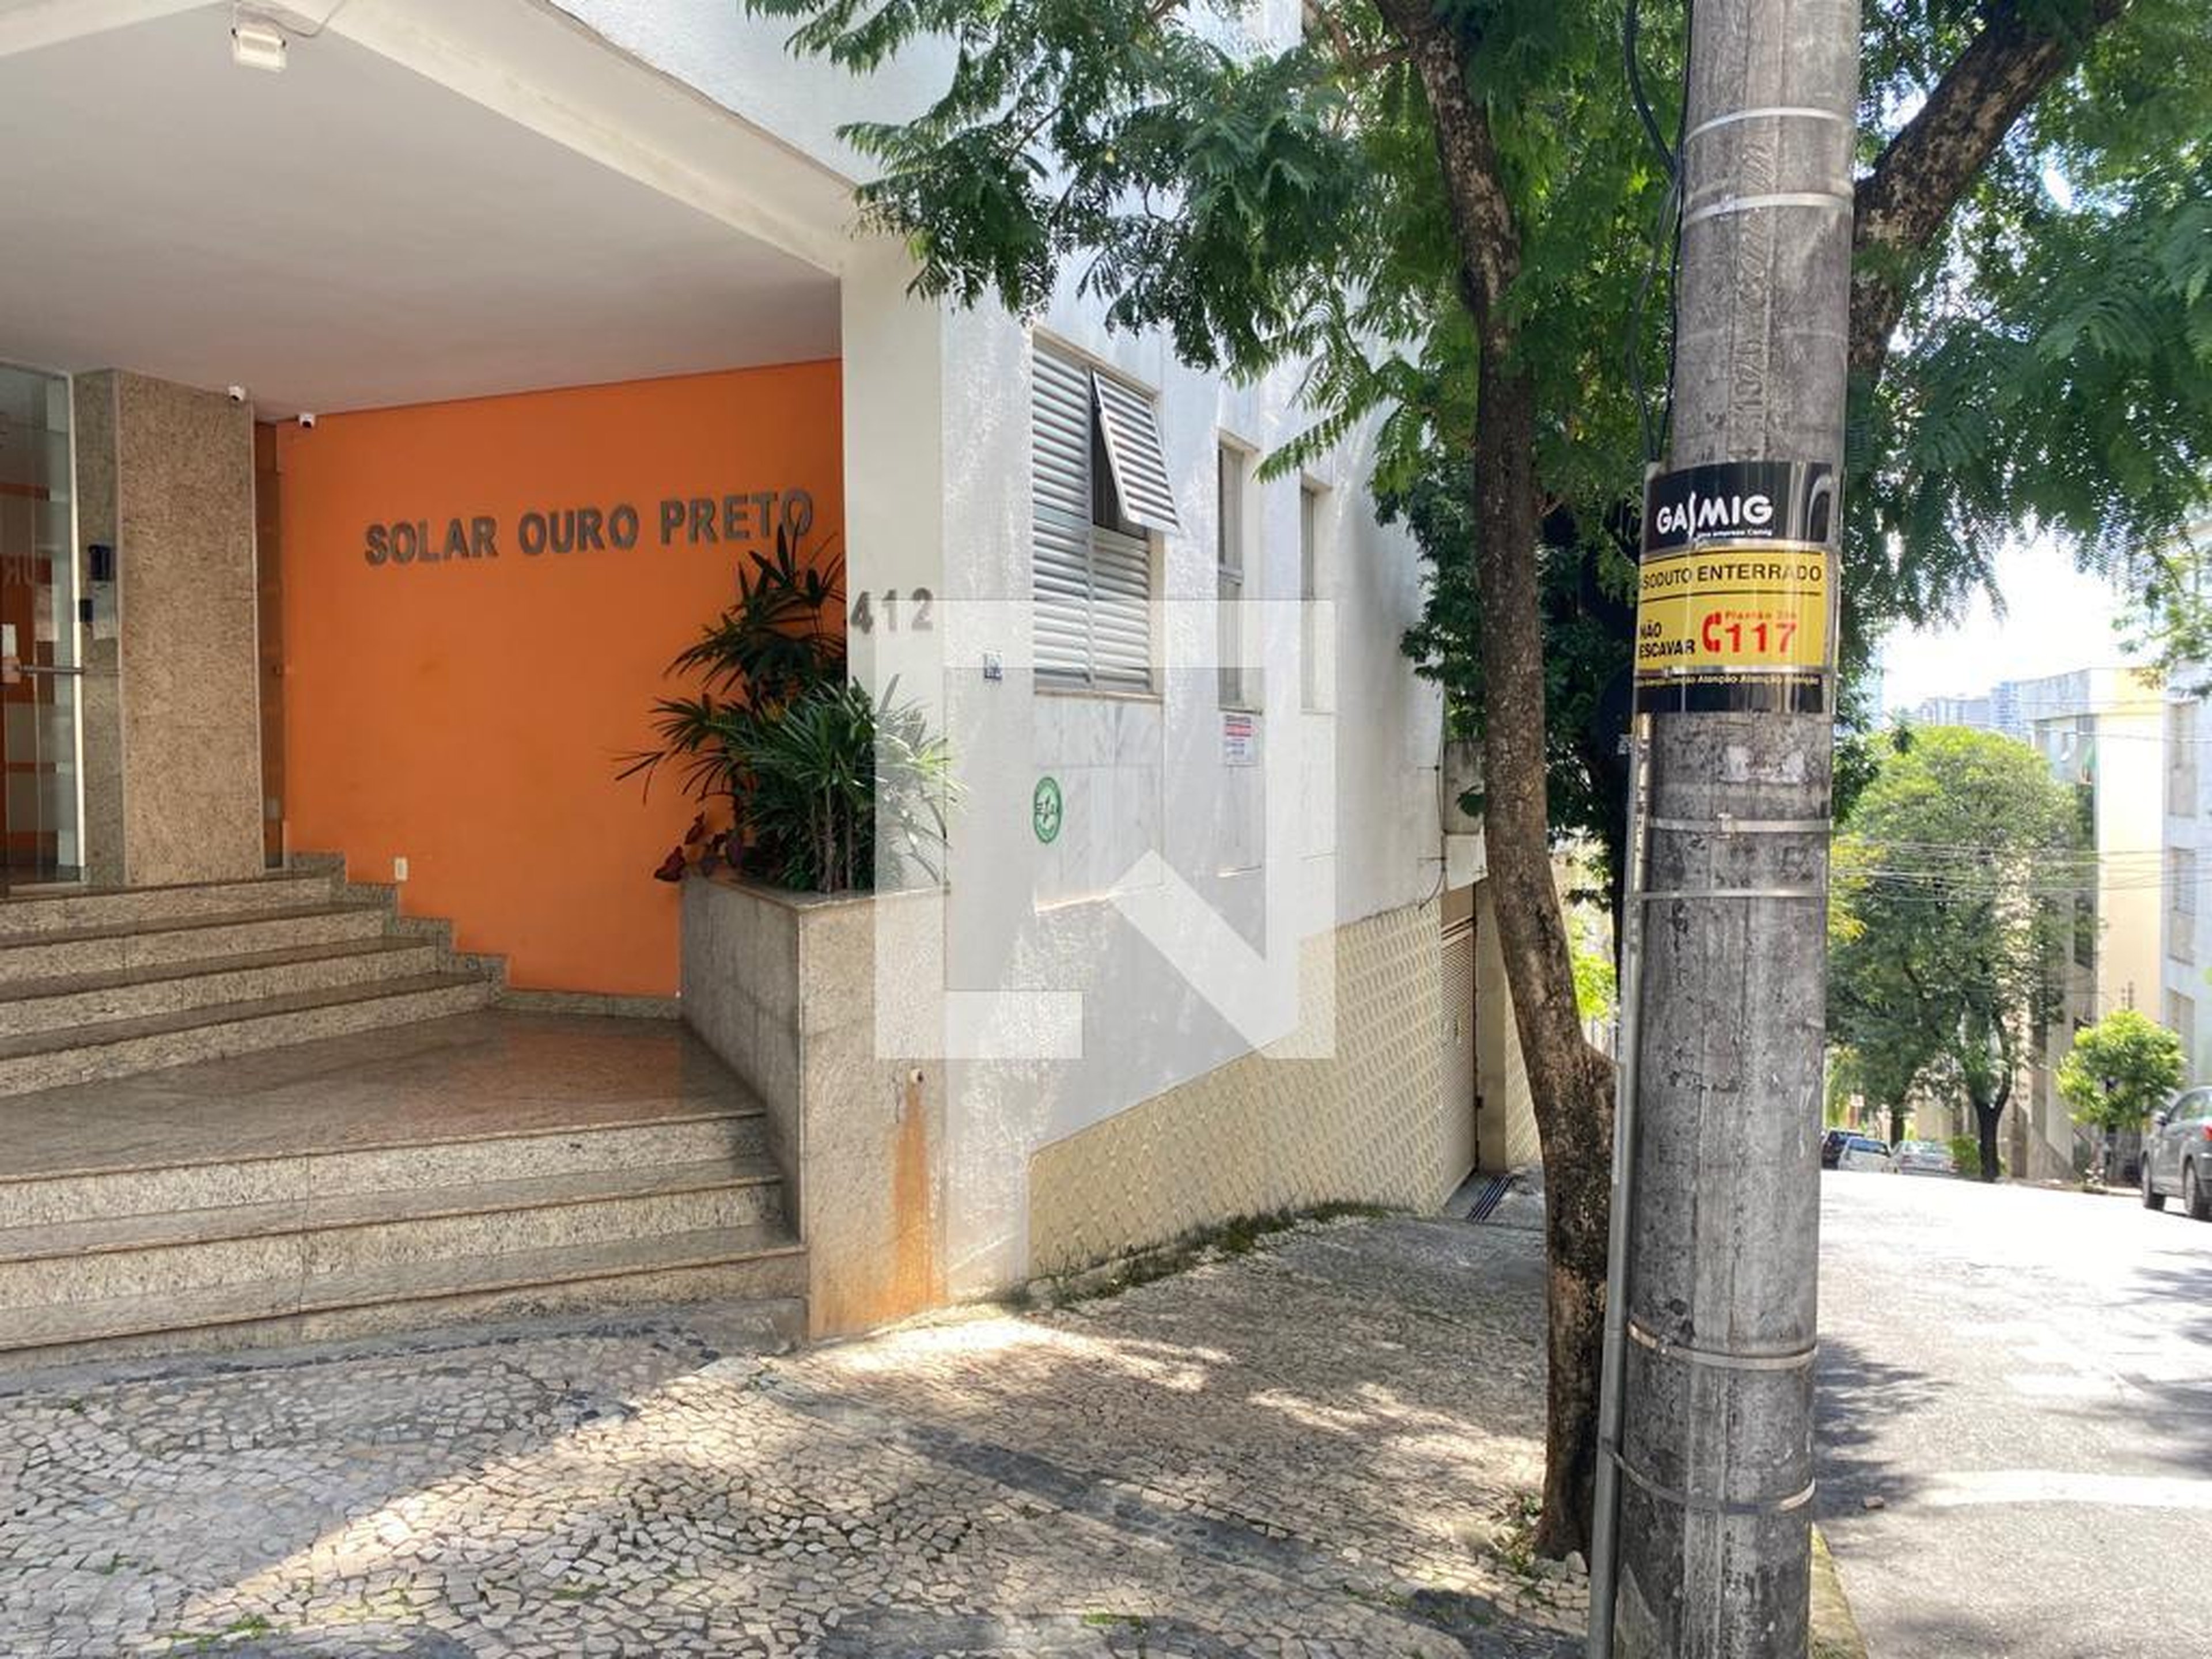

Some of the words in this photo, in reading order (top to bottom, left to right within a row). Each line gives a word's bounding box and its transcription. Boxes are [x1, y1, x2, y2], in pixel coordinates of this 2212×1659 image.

[365, 516, 499, 566] SOLAR
[518, 505, 639, 555] OURO
[661, 489, 813, 544] PRETO
[1657, 490, 1772, 538] GASMIG
[1697, 563, 1821, 582] ENTERRADO
[850, 588, 933, 634] 412
[1639, 639, 1695, 660] ESCAVAR
[1724, 623, 1797, 653] 117
